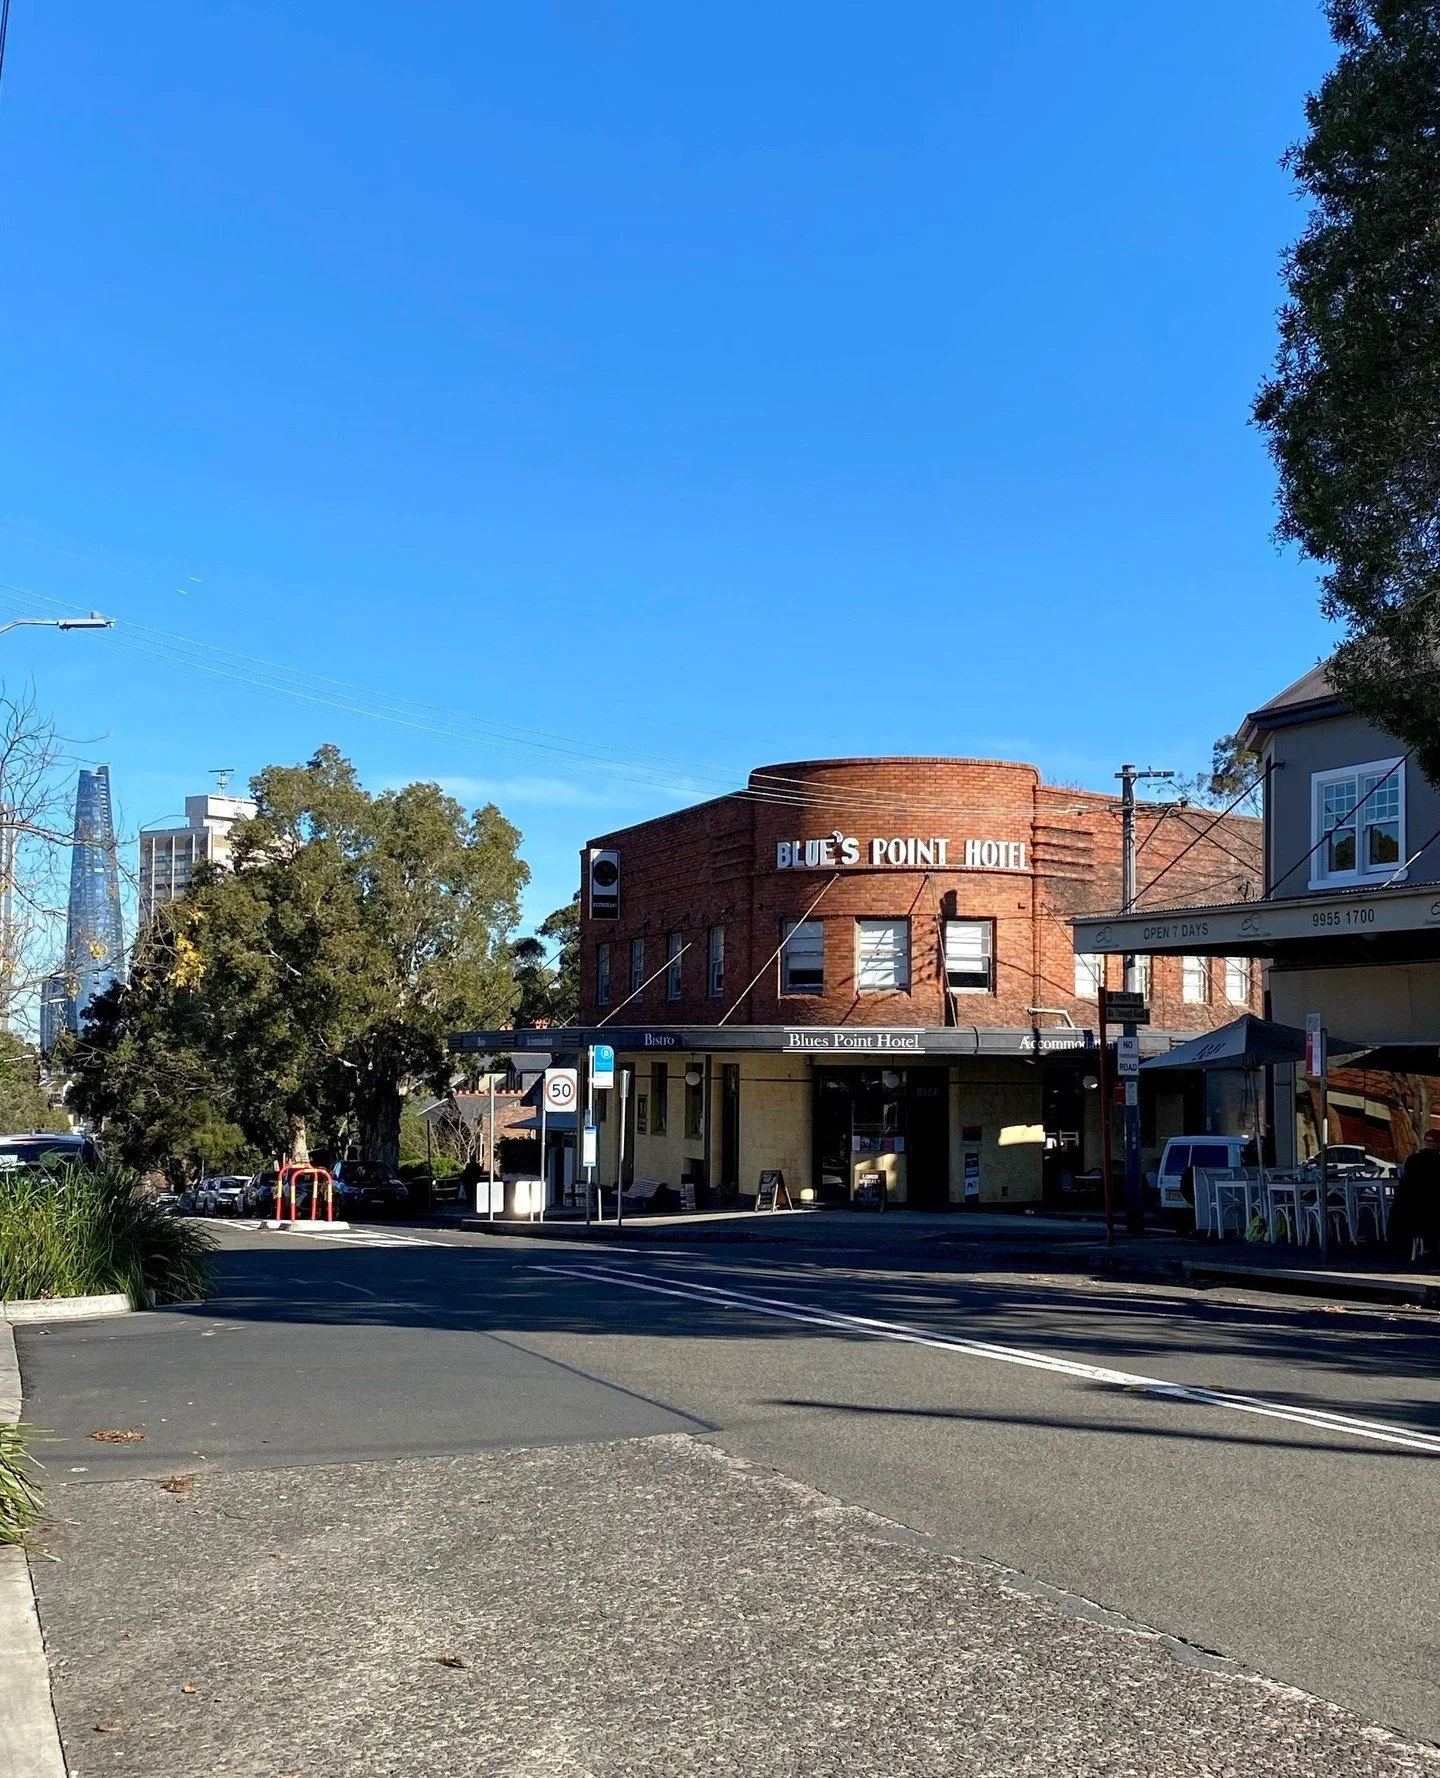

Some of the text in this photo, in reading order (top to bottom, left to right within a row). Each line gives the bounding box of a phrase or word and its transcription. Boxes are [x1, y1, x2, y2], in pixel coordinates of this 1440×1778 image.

[776, 829, 1029, 870] BLUE'S POINT HOTEL
[1312, 908, 1375, 927] 9955 1700
[1143, 922, 1209, 941] OPEN 7 DAYS
[644, 1032, 675, 1047] Bistro
[788, 1033, 919, 1048] Blues Point Hotel
[1019, 1035, 1114, 1050] Accommodatin
[1122, 1040, 1133, 1049] NO
[1119, 1063, 1137, 1072] ROAD
[551, 1083, 571, 1098] 50
